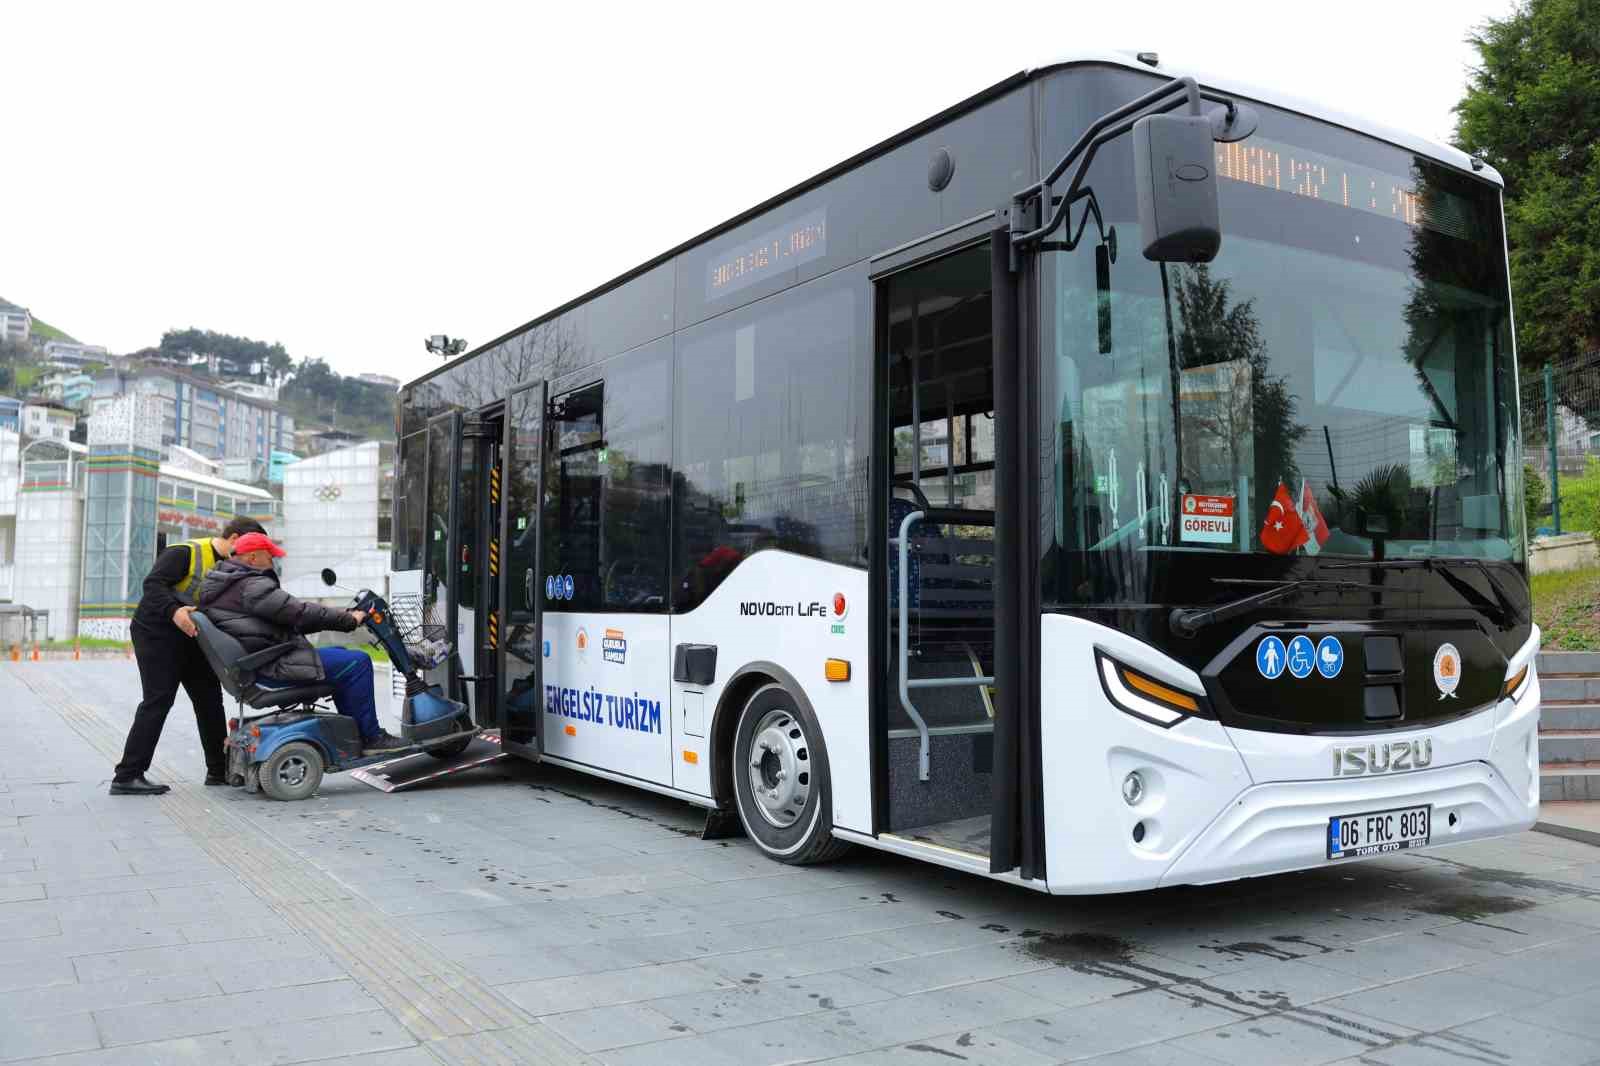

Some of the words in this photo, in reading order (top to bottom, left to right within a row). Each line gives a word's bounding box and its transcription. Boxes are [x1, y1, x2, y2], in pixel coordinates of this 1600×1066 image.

[546, 685, 604, 724] ENGELSİZ
[605, 691, 662, 734] TURİZM
[1332, 736, 1432, 776] ISUZU
[1341, 820, 1359, 847] 06
[1367, 815, 1393, 843] FRC
[1400, 811, 1426, 838] 803
[1382, 842, 1400, 852] OTO
